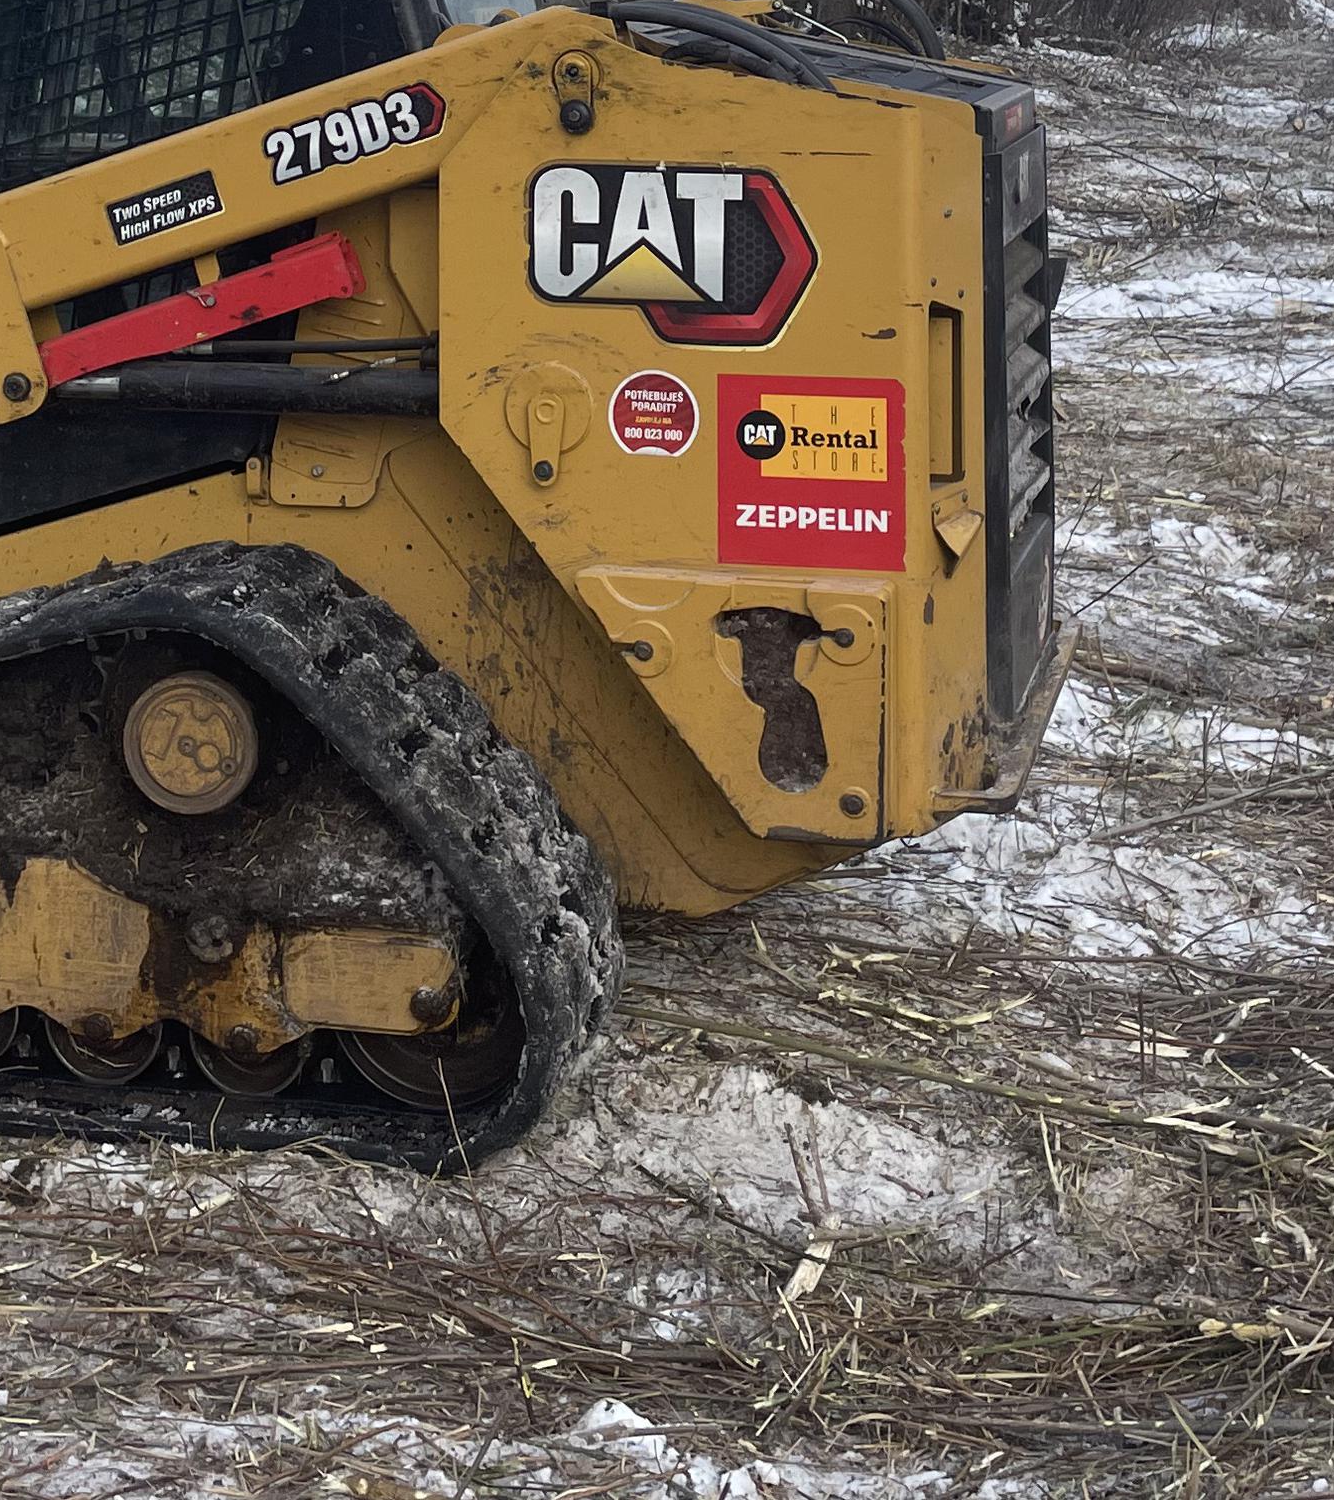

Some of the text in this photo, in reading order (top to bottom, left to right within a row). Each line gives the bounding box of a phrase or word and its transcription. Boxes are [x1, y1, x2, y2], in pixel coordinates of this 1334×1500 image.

[266, 92, 420, 183] 279D3
[188, 195, 216, 218] XPS
[533, 166, 744, 302] CAT
[790, 404, 876, 427] THE
[624, 427, 683, 442] 800 023 000
[743, 424, 777, 446] CAT
[790, 426, 879, 450] Rental
[735, 504, 889, 534] ZEPPELIN
